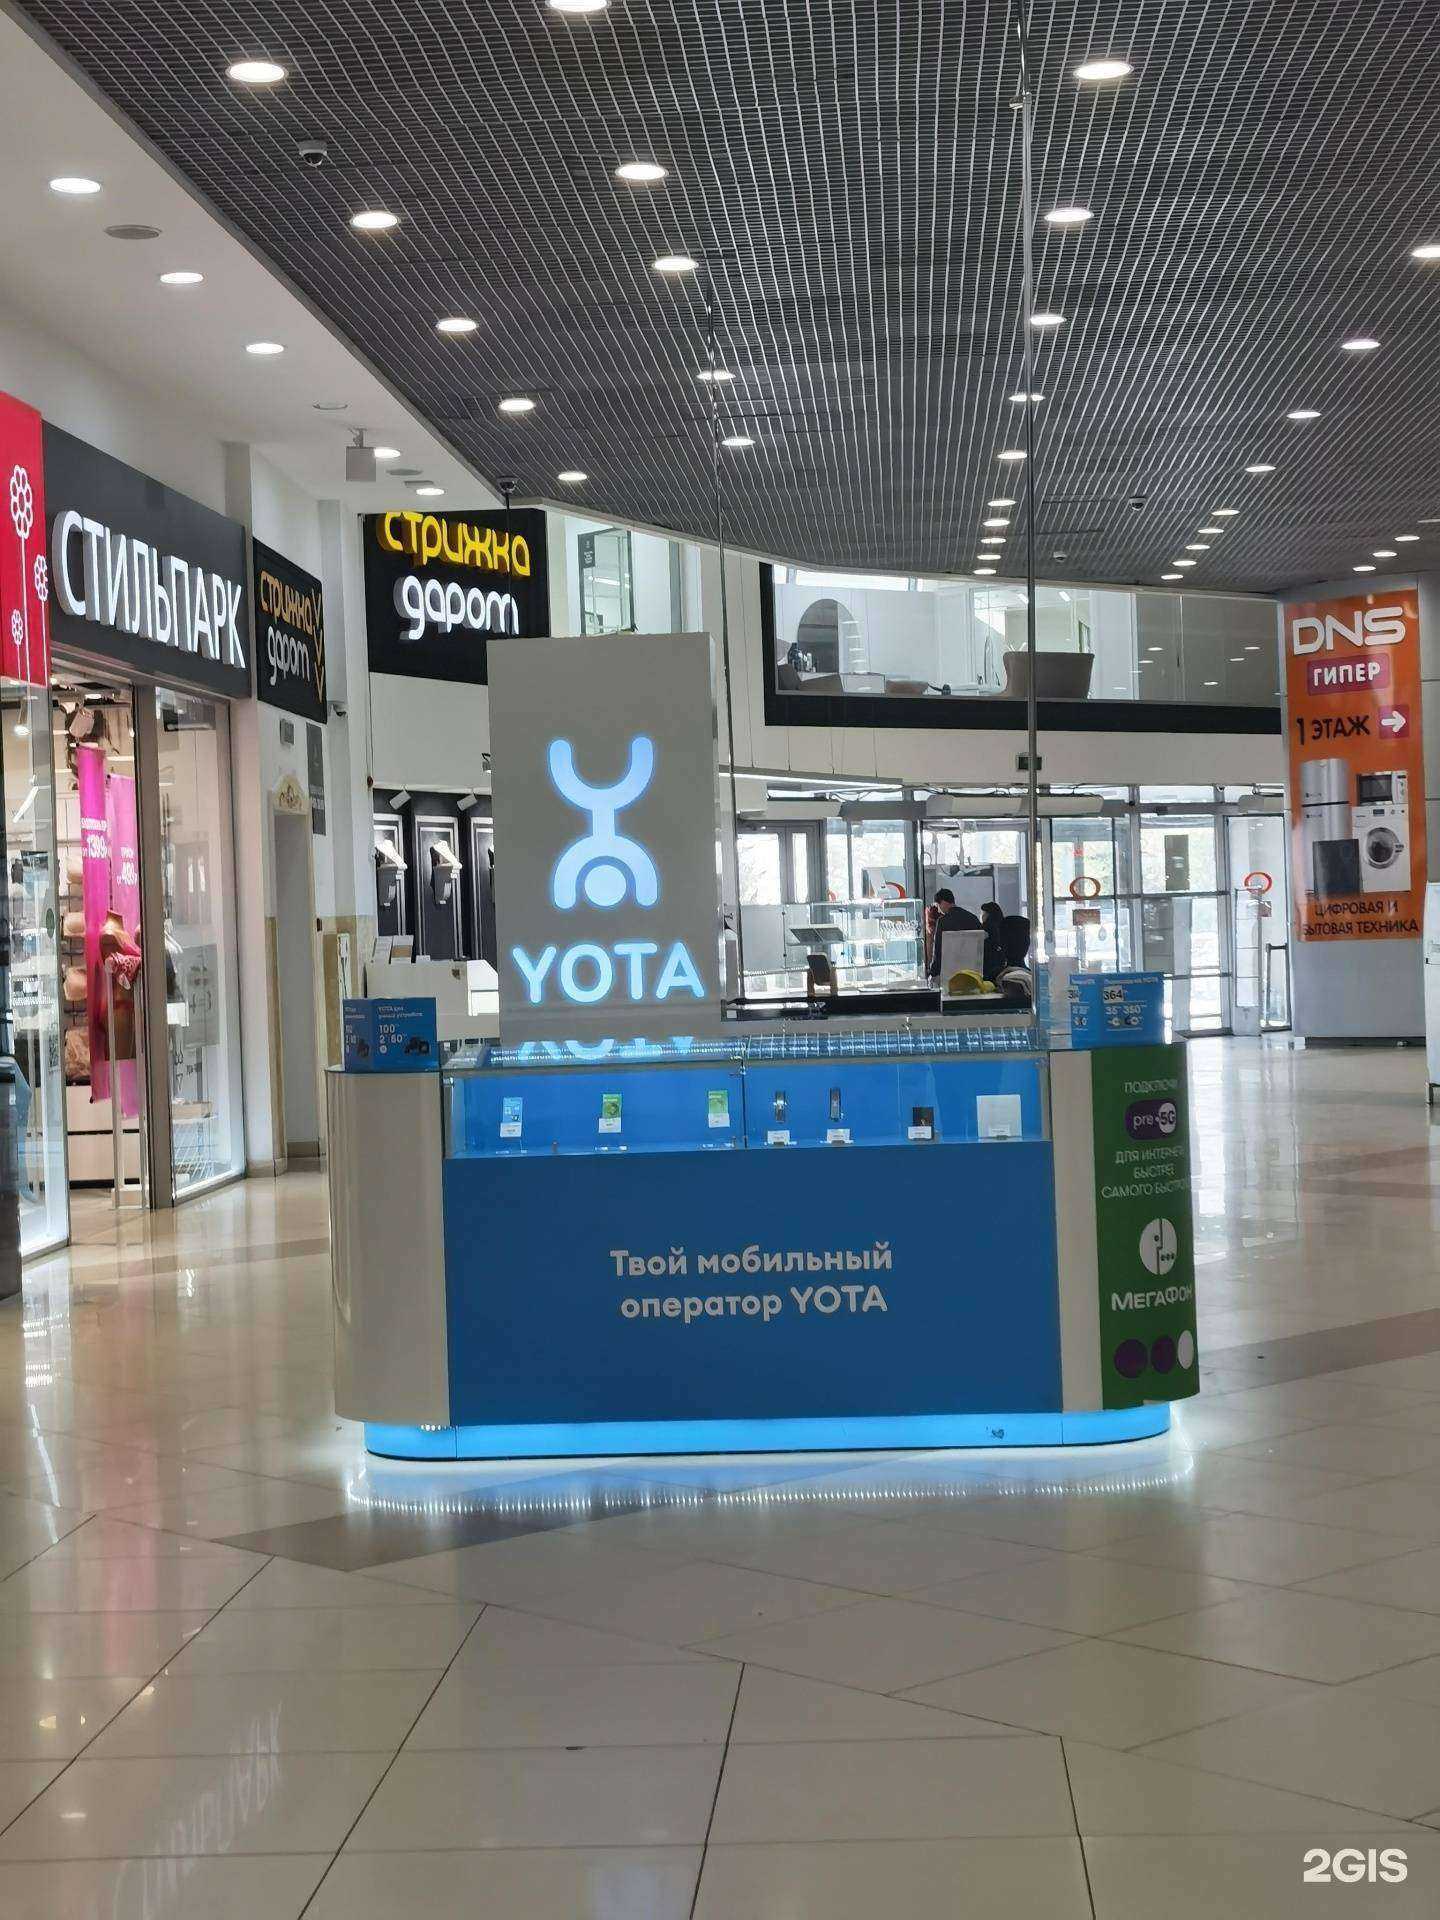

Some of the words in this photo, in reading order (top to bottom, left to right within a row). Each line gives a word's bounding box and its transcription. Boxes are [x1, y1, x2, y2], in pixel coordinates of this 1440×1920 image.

[53, 511, 246, 668] СТИЛЬПАРК
[1293, 606, 1406, 655] DNS
[1313, 662, 1381, 687] ГИПЕР
[1297, 717, 1305, 746] 1
[1311, 715, 1370, 740] ЭТАЖ
[1315, 901, 1384, 917] ЦИФРОВАЯ
[1357, 918, 1419, 934] ТЕХНИКА
[512, 942, 706, 1003] YOTA
[1115, 1151, 1139, 1164] ДЛЯ
[1101, 1184, 1153, 1199] САМОГО
[610, 1247, 687, 1276] Твой
[698, 1241, 892, 1274] мобильный
[621, 1295, 782, 1323] оператор
[790, 1285, 888, 1314] YOTA
[1111, 1285, 1193, 1311] МЕГАФОН
